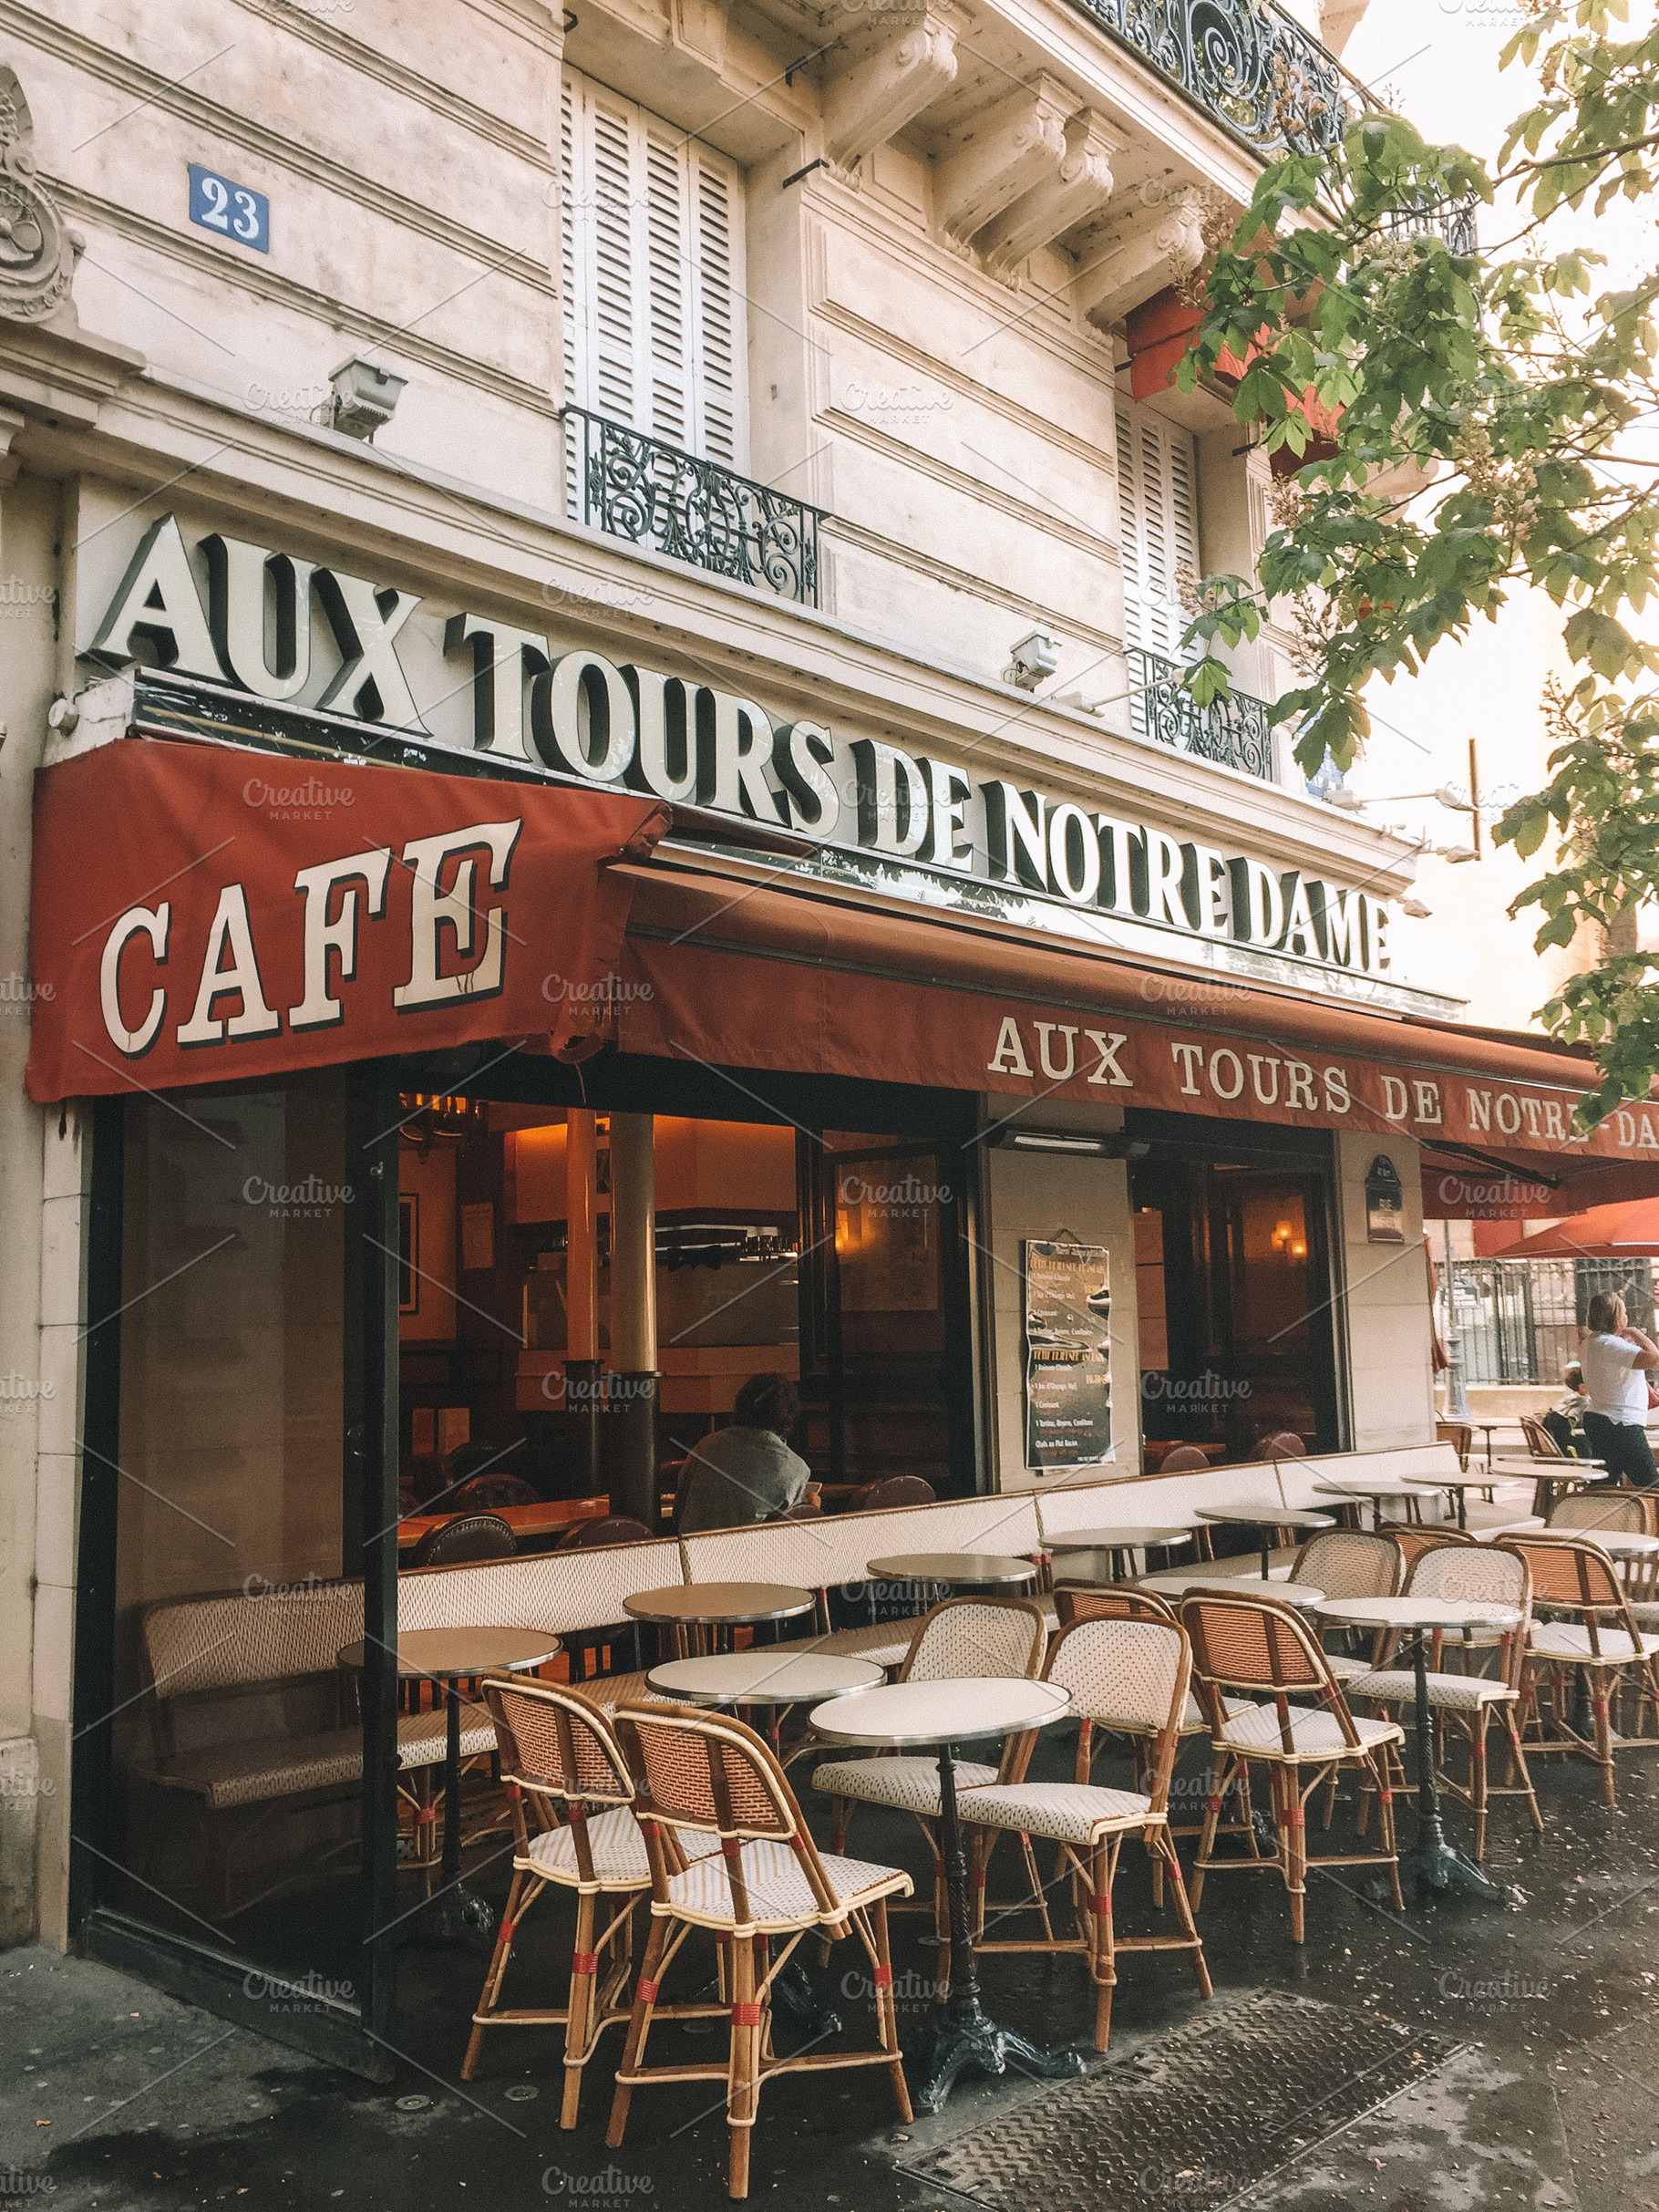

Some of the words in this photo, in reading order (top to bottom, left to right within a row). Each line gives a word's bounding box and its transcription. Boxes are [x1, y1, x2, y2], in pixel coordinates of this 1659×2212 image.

[201, 177, 260, 239] 23
[77, 512, 433, 738] AUX
[446, 612, 840, 837] TOURS
[850, 739, 973, 873] DE
[981, 780, 1229, 938] NOTRE
[1229, 856, 1390, 973] DAME
[99, 818, 521, 1058] CAFE
[987, 1017, 1133, 1087] AUX
[1171, 1042, 1351, 1115] TOURS
[1381, 1075, 1442, 1124] DE
